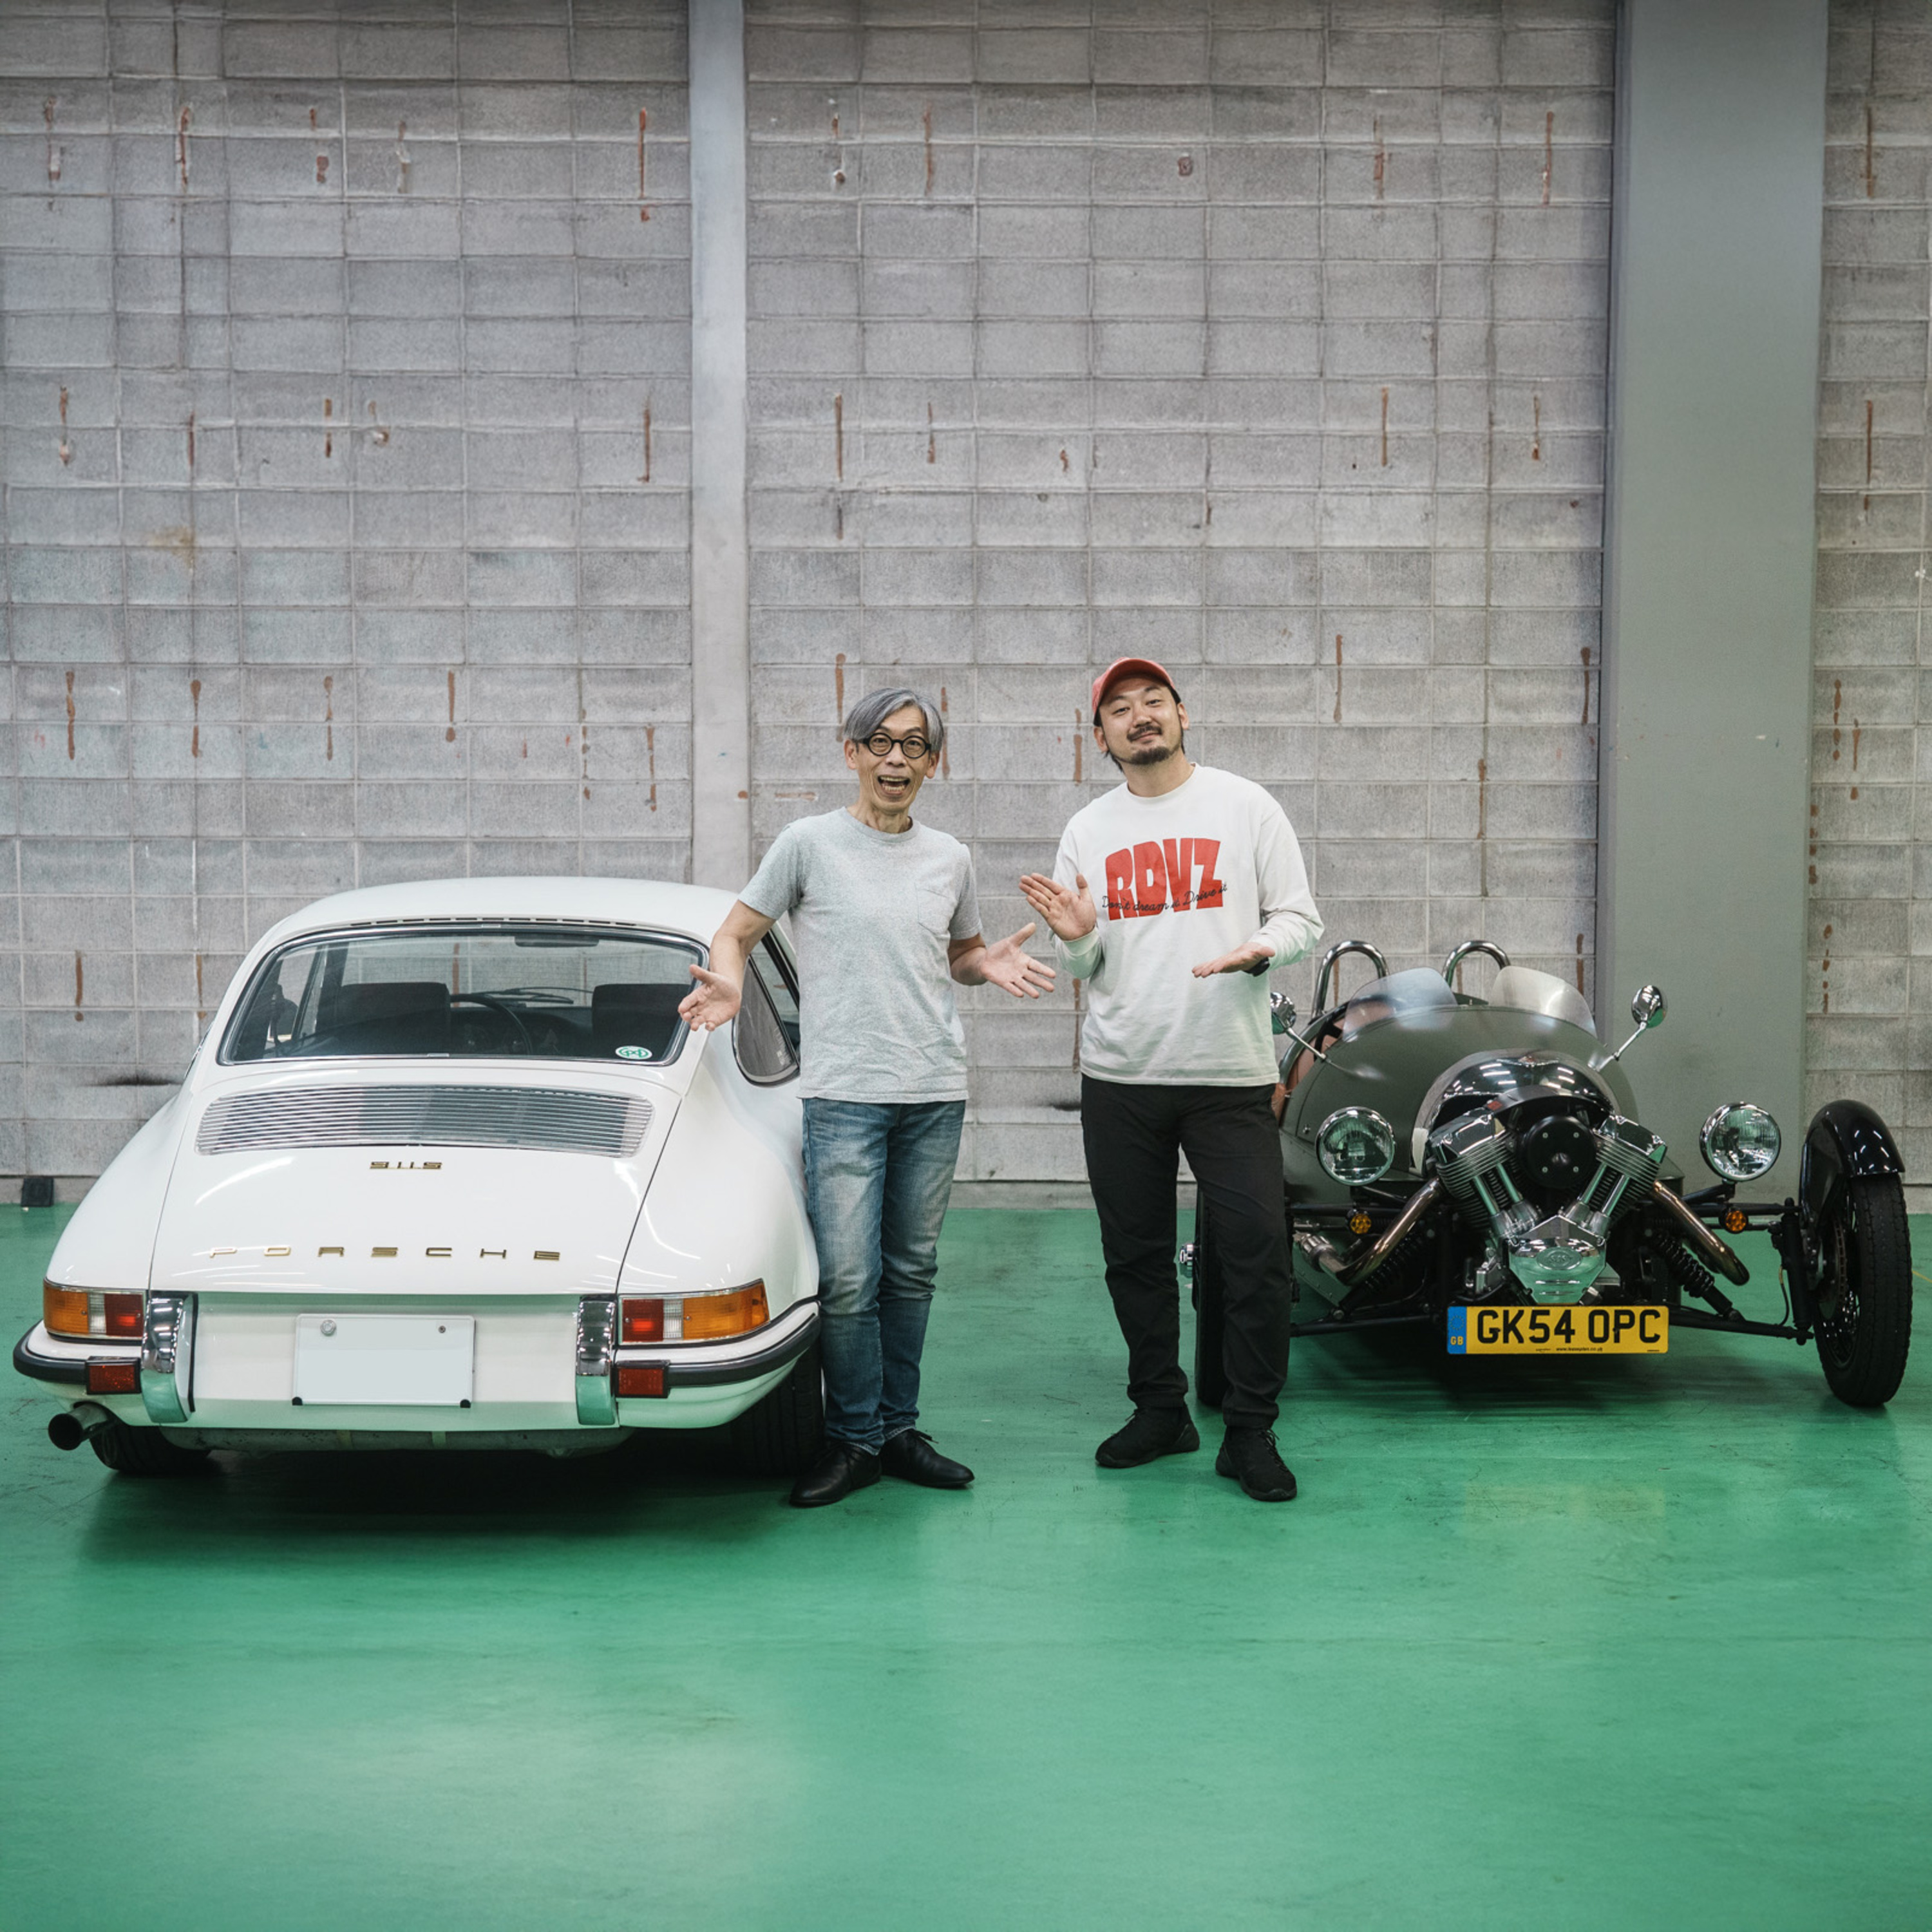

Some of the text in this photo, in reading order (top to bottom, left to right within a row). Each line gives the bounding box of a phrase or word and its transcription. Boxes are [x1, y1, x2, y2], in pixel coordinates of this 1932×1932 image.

[1105, 838, 1224, 920] RDVZ
[1102, 895, 1131, 910] Don't
[1133, 900, 1169, 911] dream
[1182, 891, 1215, 906] Drive
[1217, 883, 1227, 893] it
[210, 1246, 560, 1260] PORSCHE
[1477, 1309, 1661, 1344] GK54 OPC
[1450, 1336, 1464, 1346] GB
